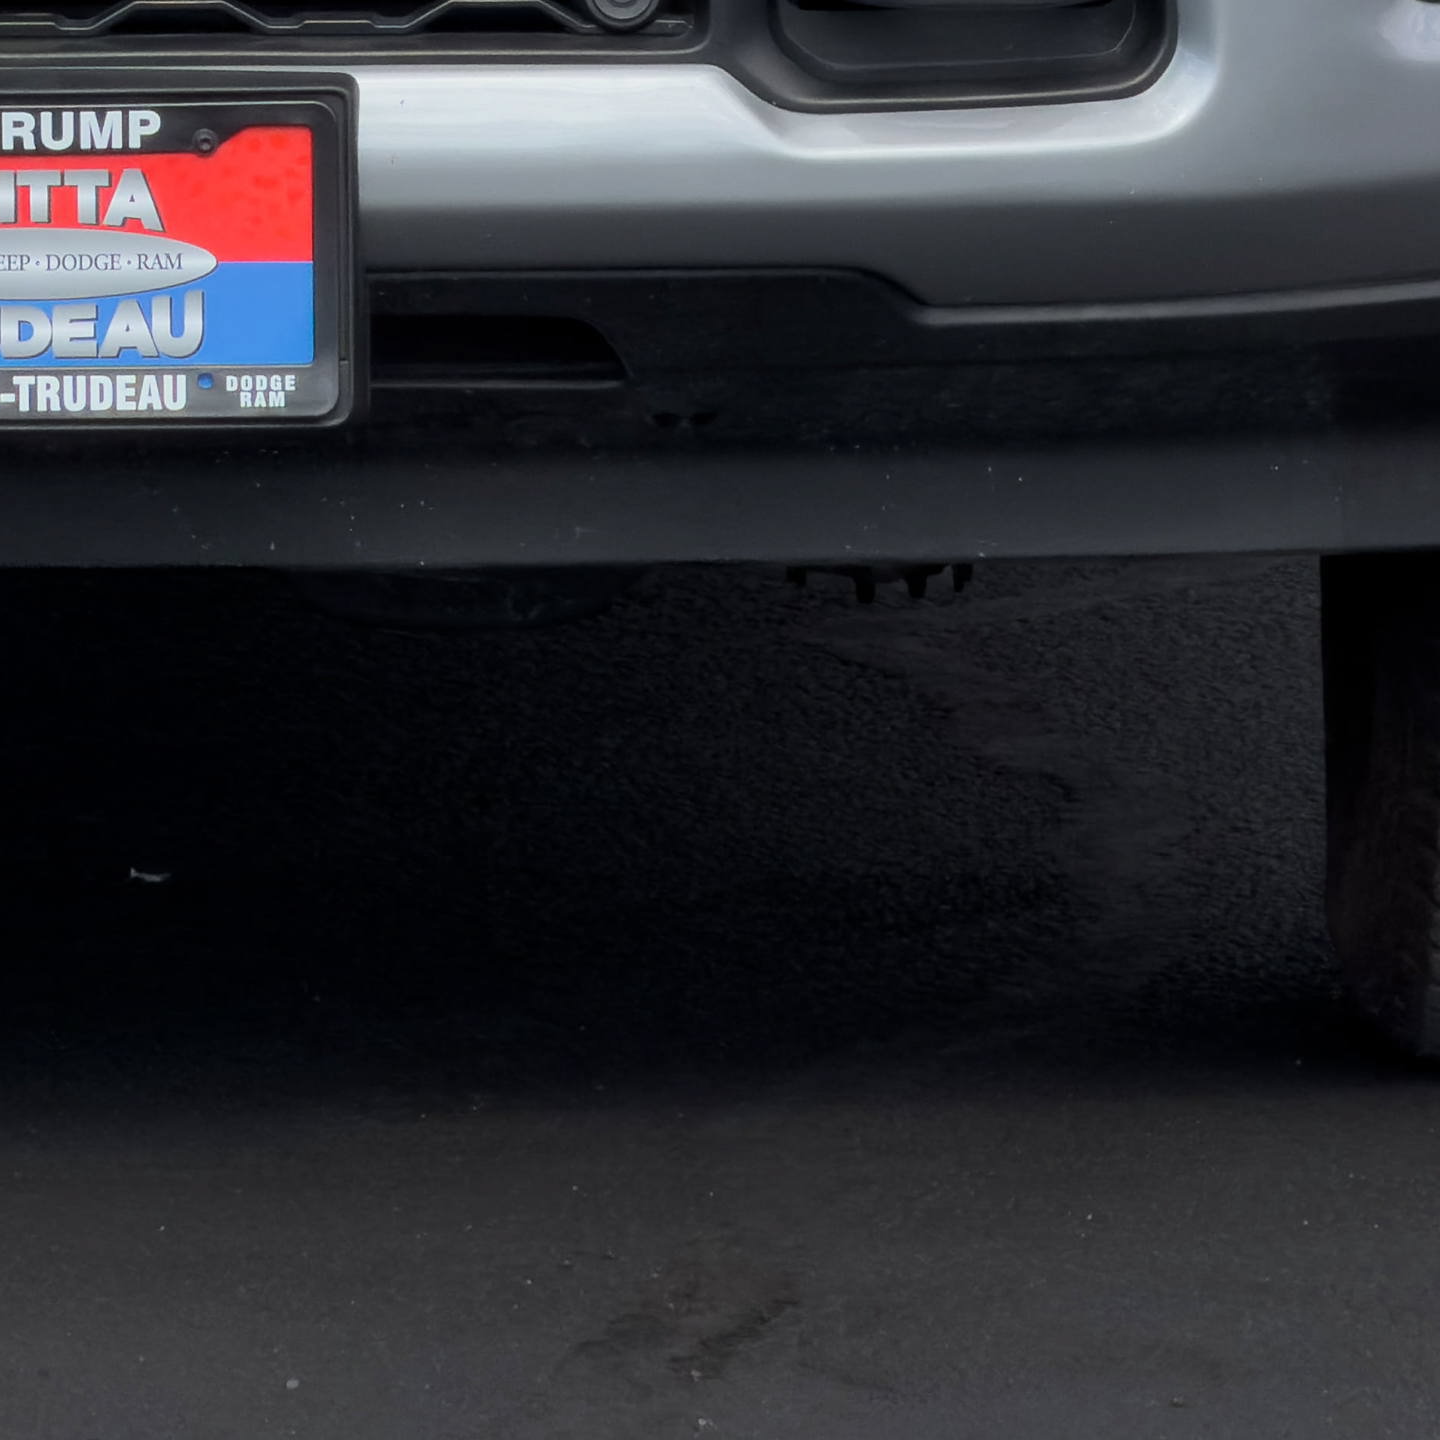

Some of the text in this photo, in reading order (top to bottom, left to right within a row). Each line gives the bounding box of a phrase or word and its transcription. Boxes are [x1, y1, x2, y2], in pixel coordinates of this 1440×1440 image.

[45, 253, 122, 271] DODGE
[136, 252, 184, 271] RAM
[225, 374, 296, 392] DODGE
[239, 390, 286, 408] RAM
